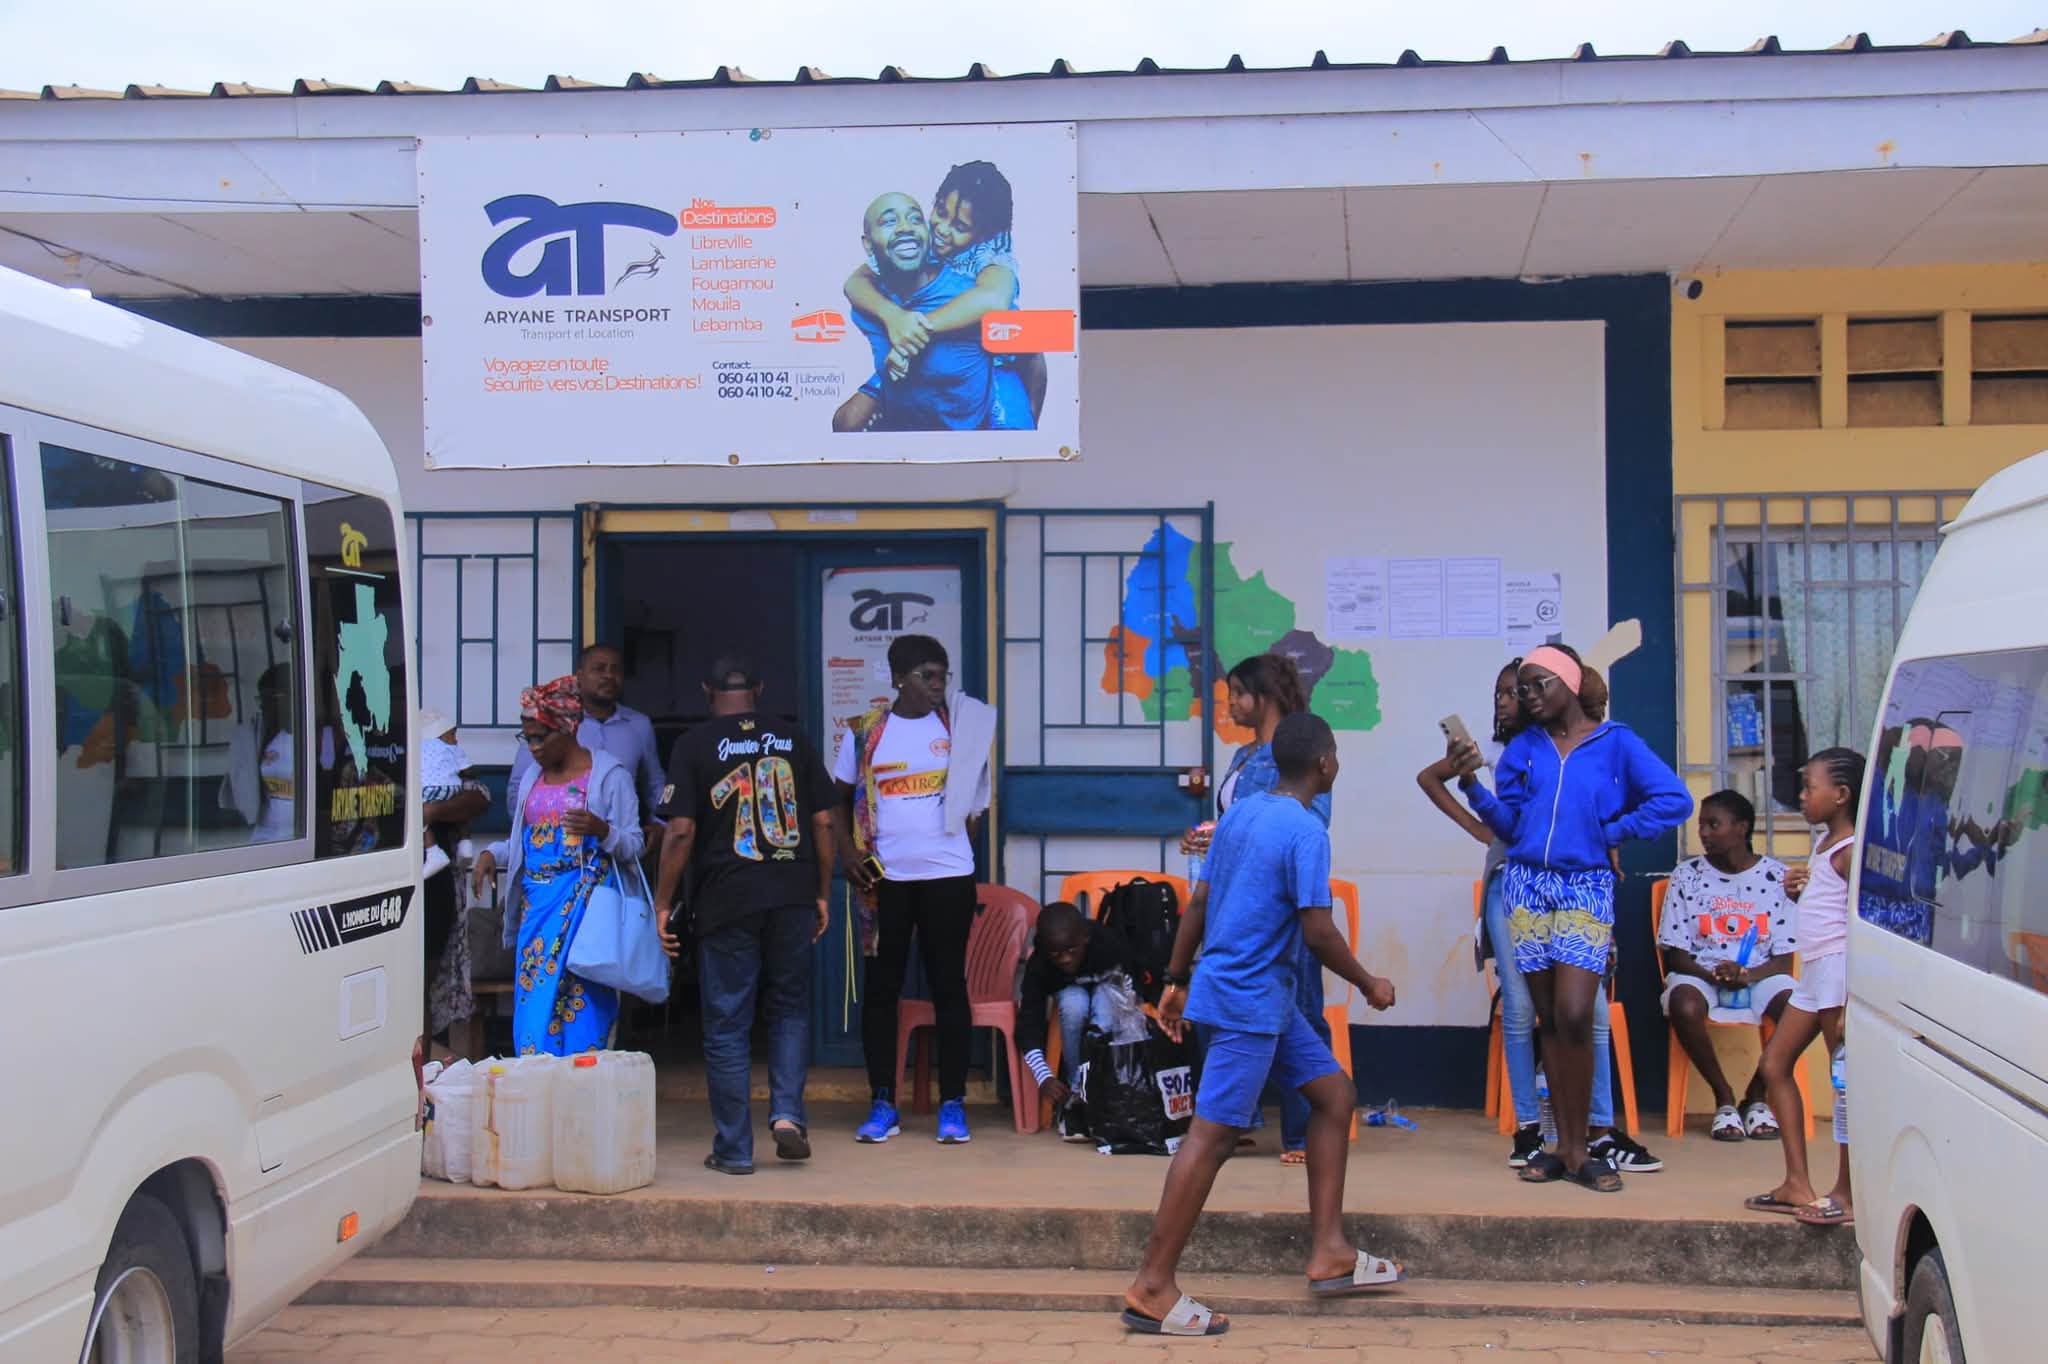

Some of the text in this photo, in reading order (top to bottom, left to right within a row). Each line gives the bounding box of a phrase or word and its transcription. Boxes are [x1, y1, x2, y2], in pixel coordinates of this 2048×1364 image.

[683, 208, 775, 225] Destinations
[691, 235, 753, 250] Libreville
[692, 276, 774, 293] Fougamou
[692, 296, 741, 312] Mouila
[484, 308, 671, 324] ARYANE TRANSPORT
[692, 316, 763, 332] Lebamba
[521, 328, 634, 342] Transport et Location
[483, 357, 609, 375] Voyagez en toute
[547, 378, 577, 391] vers
[578, 378, 605, 391] vos
[718, 372, 743, 384] 060
[745, 372, 758, 384] 41
[760, 372, 774, 384] 10
[775, 371, 789, 384] 41
[718, 387, 743, 398] 060
[745, 386, 759, 398] 41
[762, 386, 774, 398] 10
[775, 386, 793, 398] 42
[1541, 605, 1555, 616] 21
[710, 756, 800, 862] 70
[342, 895, 402, 929] L'HOMME DU G48
[1712, 896, 1755, 912] Disney
[1696, 912, 1769, 937] 101
